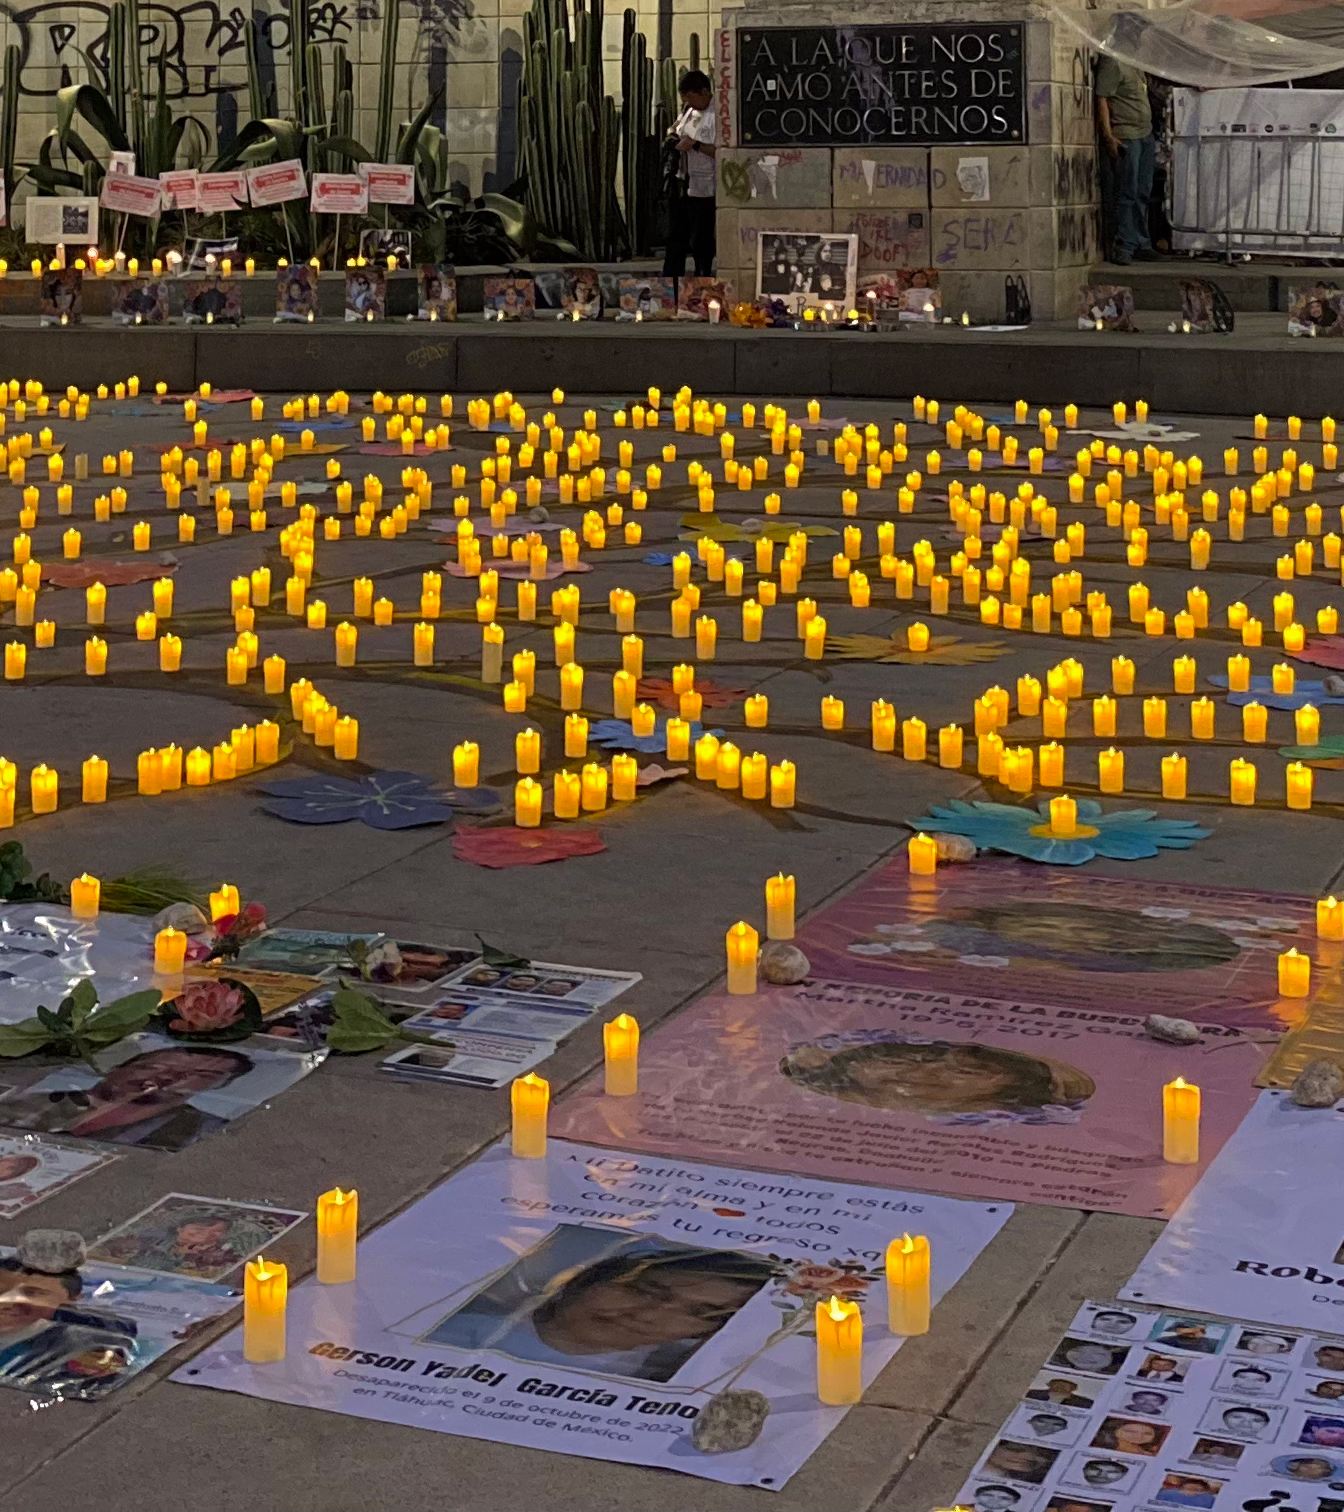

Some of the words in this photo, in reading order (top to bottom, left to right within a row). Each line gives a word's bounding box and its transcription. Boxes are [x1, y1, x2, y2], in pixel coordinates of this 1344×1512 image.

[750, 36, 778, 66] A
[790, 36, 836, 66] LA
[844, 34, 918, 67] QUE
[931, 33, 1005, 64] NOS
[746, 66, 832, 102] AMÓ
[840, 69, 958, 100] ANTES
[970, 69, 1015, 98] DE
[756, 105, 1008, 137] CONOCERNOS
[675, 1186, 746, 1206] alma
[757, 1200, 777, 1214] y
[785, 1204, 823, 1216] en
[832, 1210, 874, 1221] mi
[715, 1177, 835, 1202] siempre
[846, 1195, 925, 1215] estás
[673, 1217, 703, 1234] tu
[712, 1228, 832, 1253] regreso
[756, 1213, 842, 1236] todos
[307, 1341, 418, 1373] Gerson
[516, 1377, 619, 1408] García
[333, 1368, 458, 1395] Desaparecido
[462, 1389, 479, 1399] el
[499, 1397, 523, 1411] de
[528, 1401, 602, 1425] octubre
[606, 1417, 630, 1430] de
[353, 1386, 378, 1398] en
[462, 1403, 528, 1423] Ciudad
[533, 1416, 559, 1430] de
